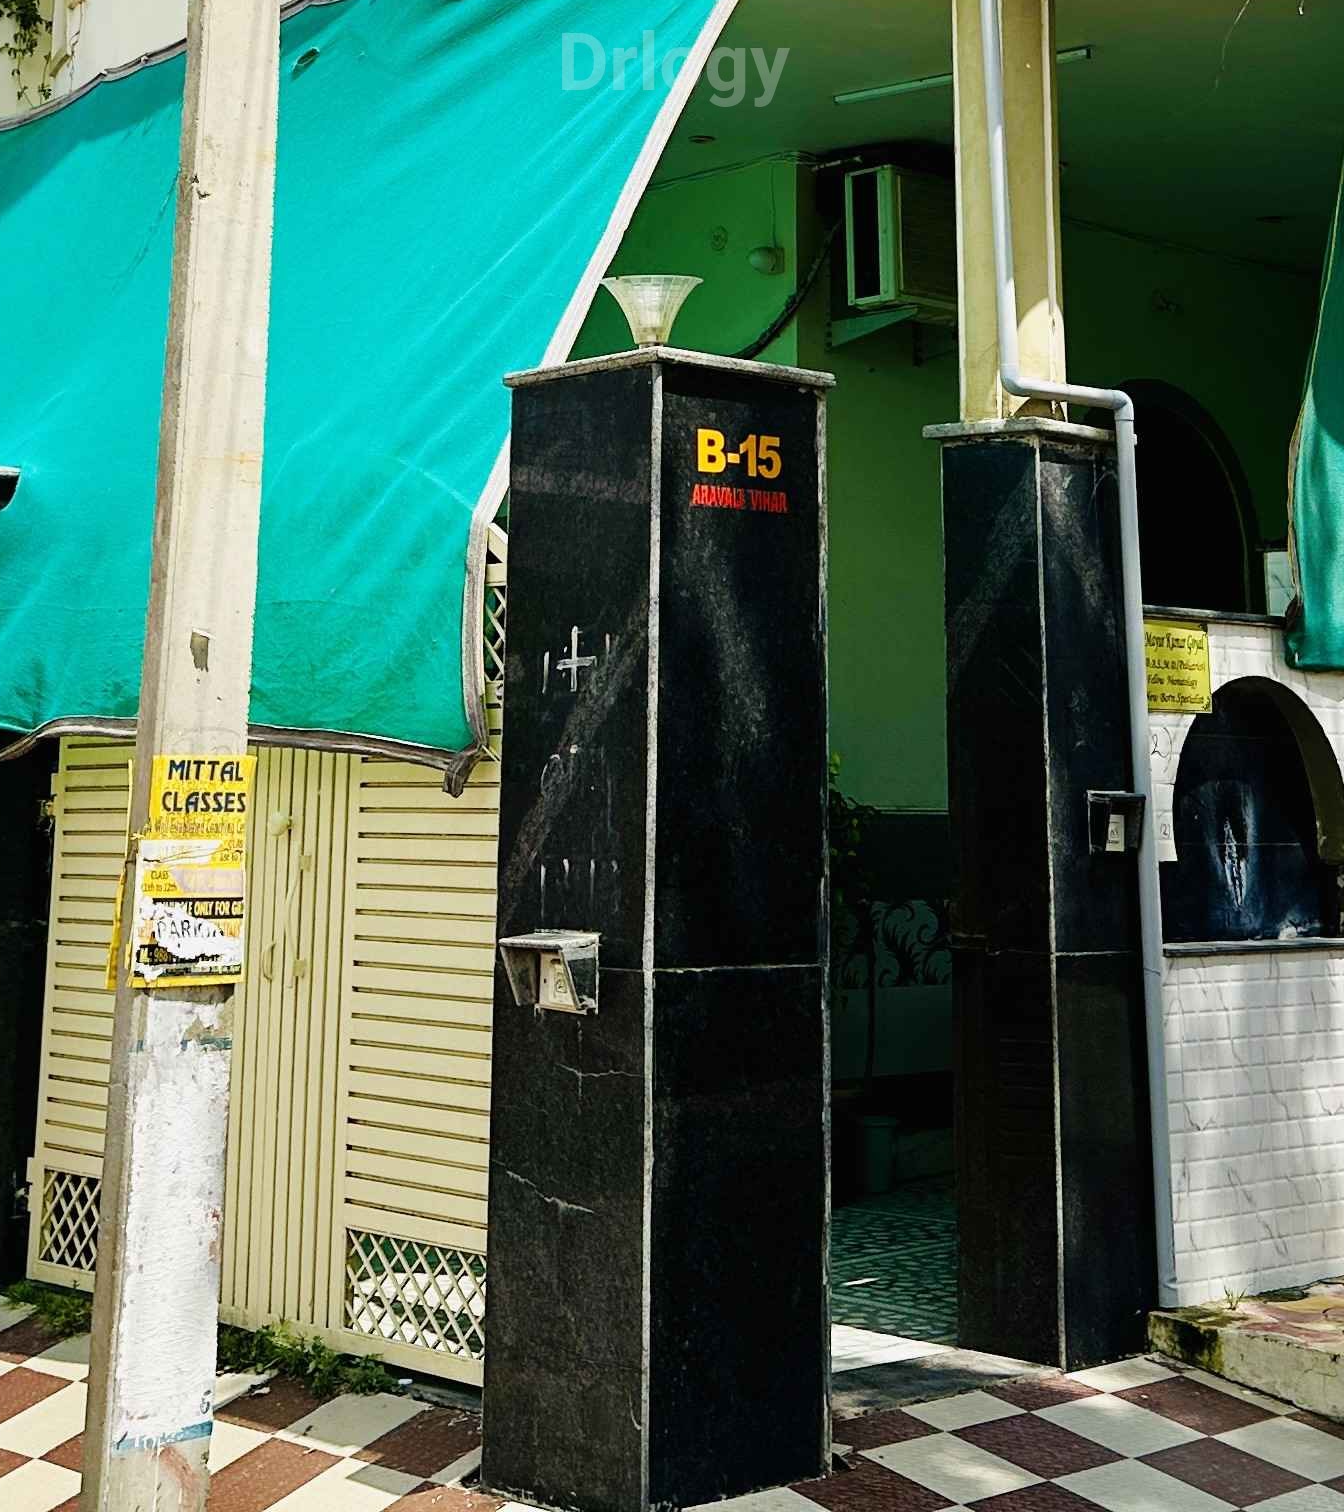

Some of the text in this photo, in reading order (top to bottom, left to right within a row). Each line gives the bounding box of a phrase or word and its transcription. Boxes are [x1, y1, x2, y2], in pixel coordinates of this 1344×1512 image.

[697, 428, 782, 479] B-15
[168, 759, 244, 783] MITTAL
[161, 791, 247, 814] CLASSES
[193, 900, 213, 916] ONLY
[215, 900, 231, 915] FOR
